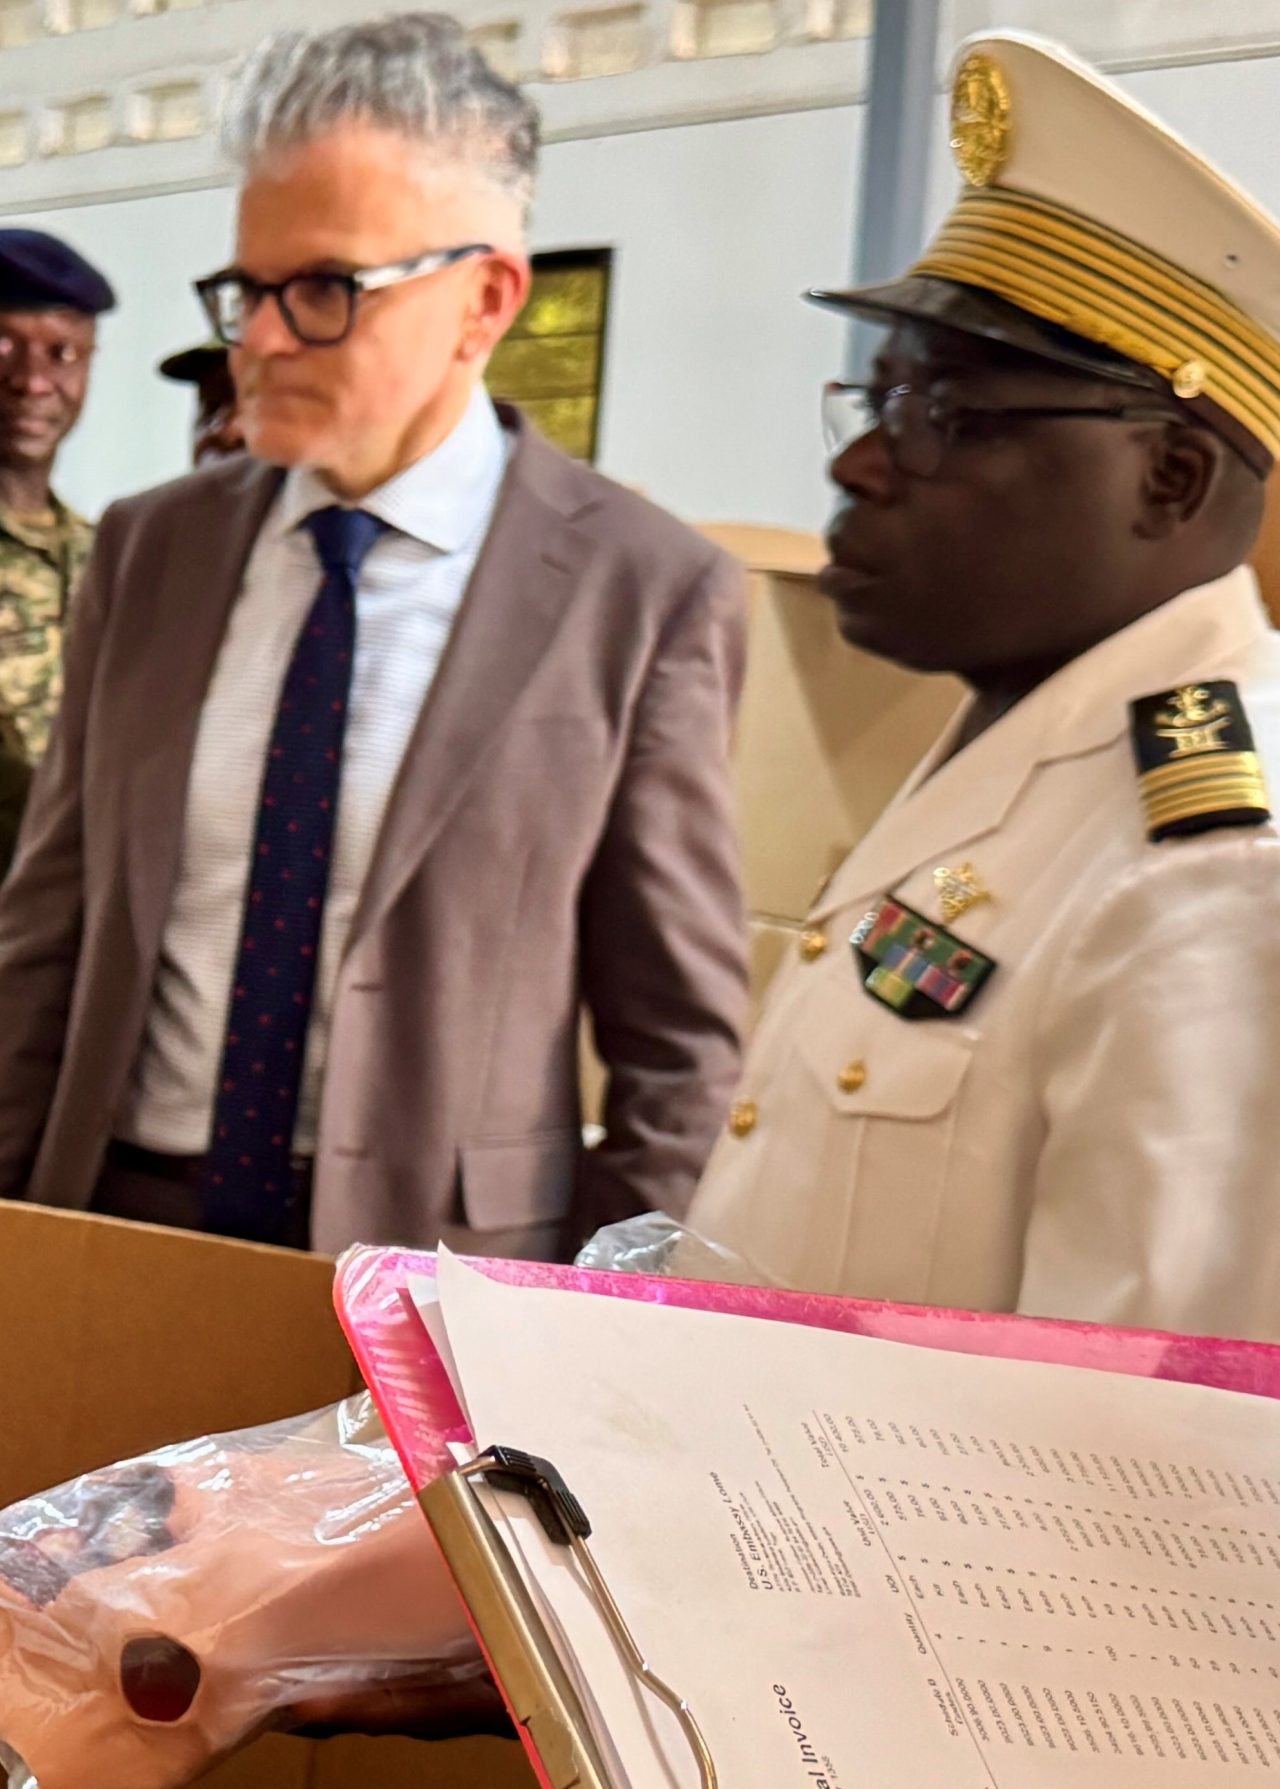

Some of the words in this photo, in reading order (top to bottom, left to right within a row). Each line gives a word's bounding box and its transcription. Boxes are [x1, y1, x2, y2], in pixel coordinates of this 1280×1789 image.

[728, 1506, 762, 1561] Embassy
[729, 1533, 759, 1590] Destination
[904, 1612, 927, 1655] Quantity
[772, 1684, 819, 1764] Invoice
